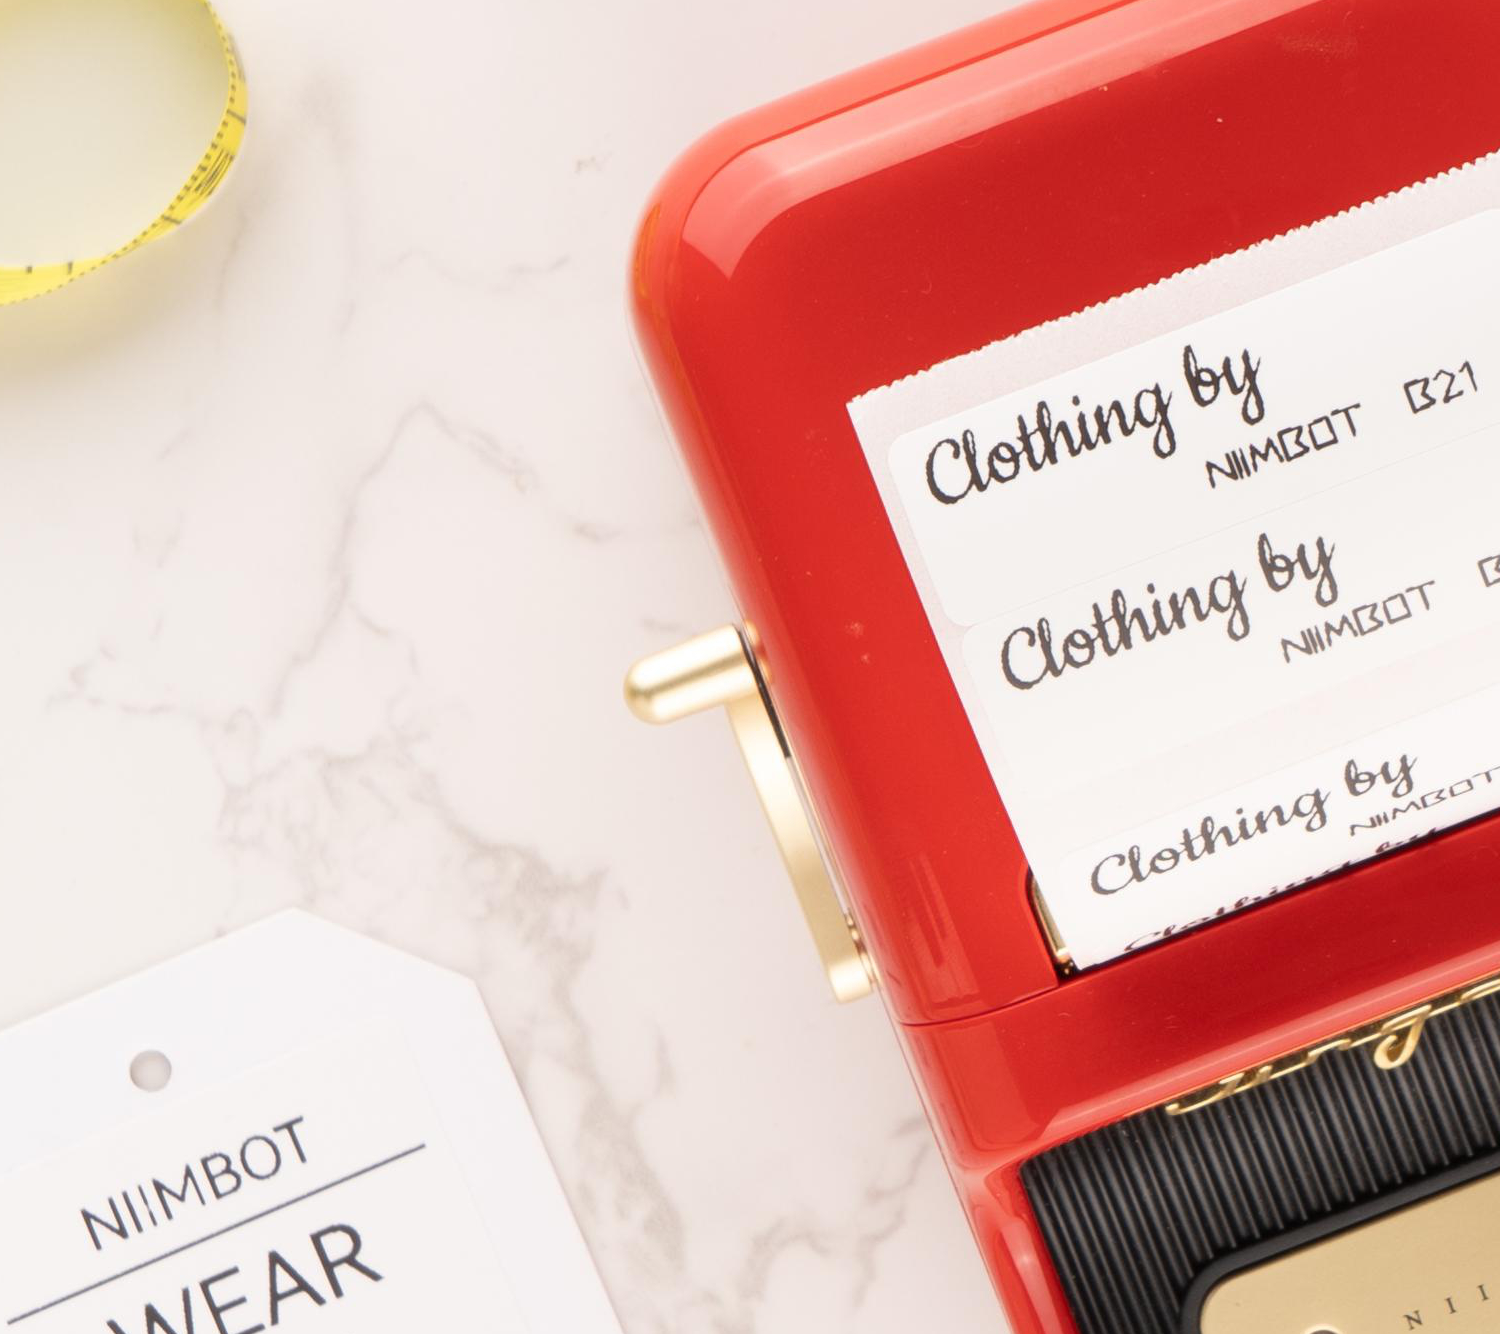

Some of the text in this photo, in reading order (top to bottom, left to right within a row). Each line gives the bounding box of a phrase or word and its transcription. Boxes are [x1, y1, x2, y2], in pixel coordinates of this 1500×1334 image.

[925, 344, 1266, 505] Clothing by
[1205, 361, 1480, 488] NIIMBOT B21
[1000, 533, 1339, 691] Clothing by
[1280, 580, 1435, 665] NIIMBOT
[1088, 779, 1331, 897] Clothing
[1343, 747, 1420, 798] by
[1348, 766, 1500, 837] NIIMBOT
[80, 1116, 309, 1251] NIIMBOT
